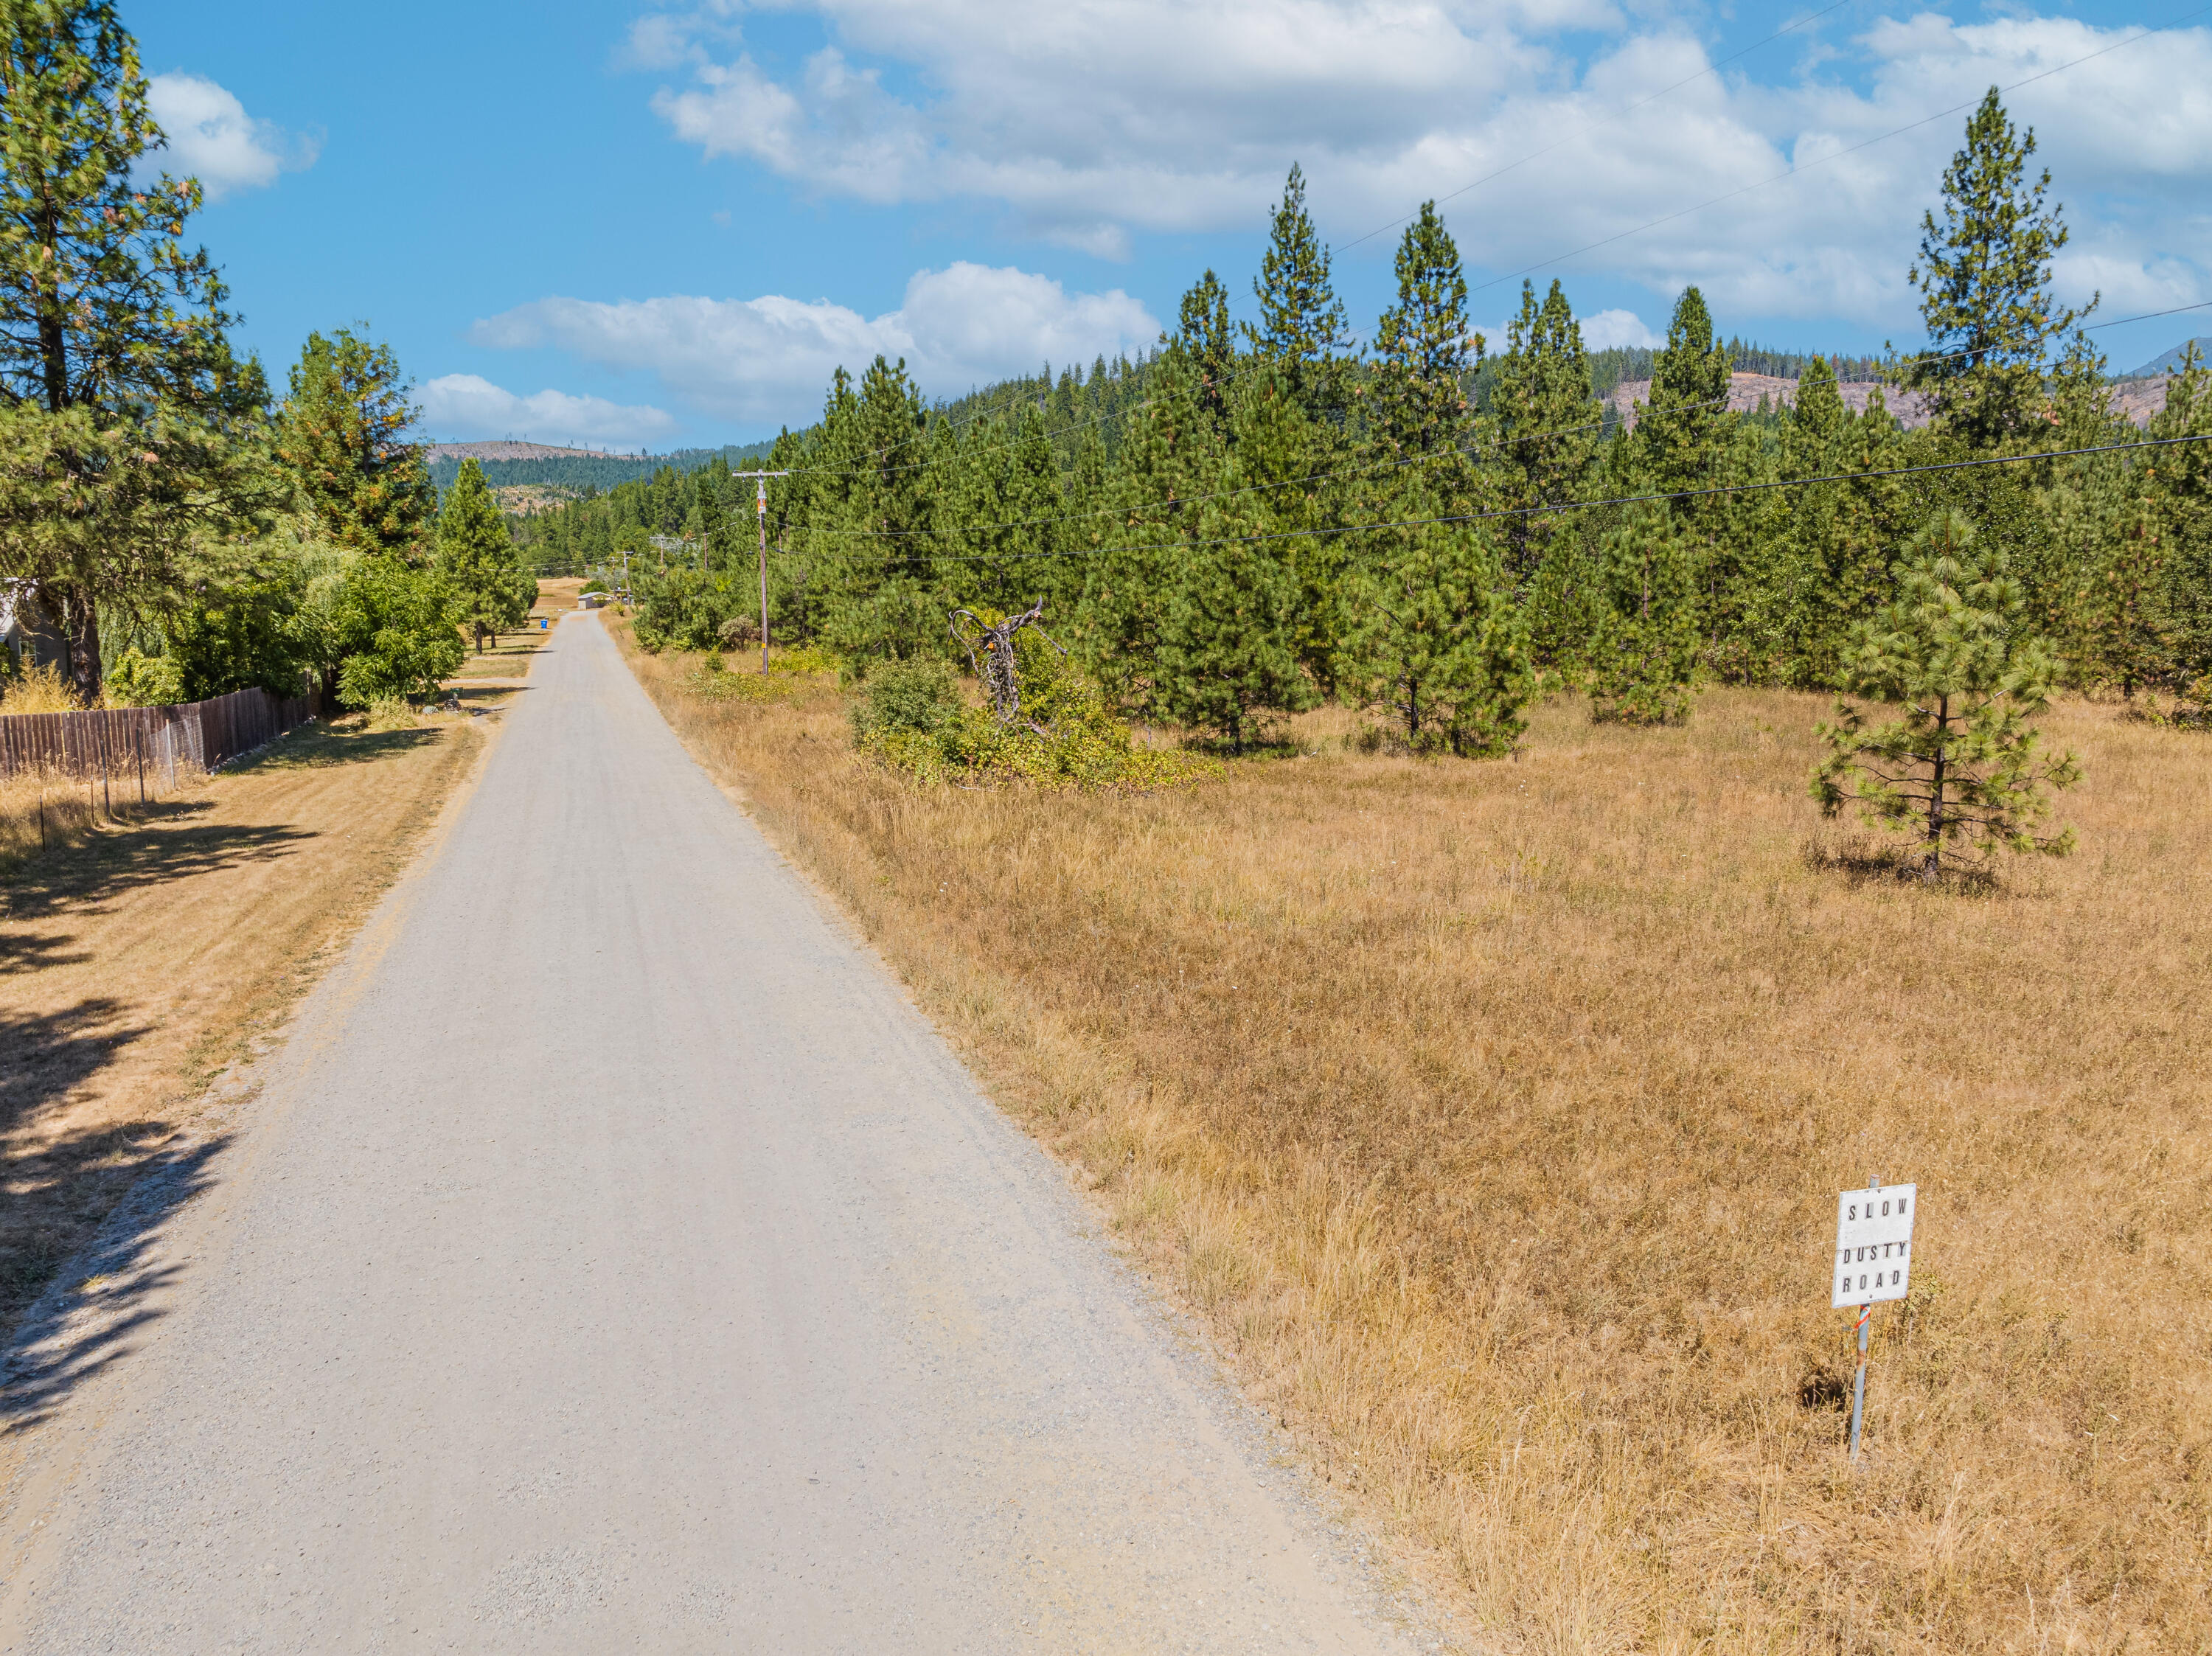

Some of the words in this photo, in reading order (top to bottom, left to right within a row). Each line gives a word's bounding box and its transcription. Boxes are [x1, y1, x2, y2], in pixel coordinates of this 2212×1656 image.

[1848, 1198, 1907, 1221] SLOW
[1843, 1242, 1905, 1263] DUSTY
[1843, 1270, 1899, 1293] ROAD
